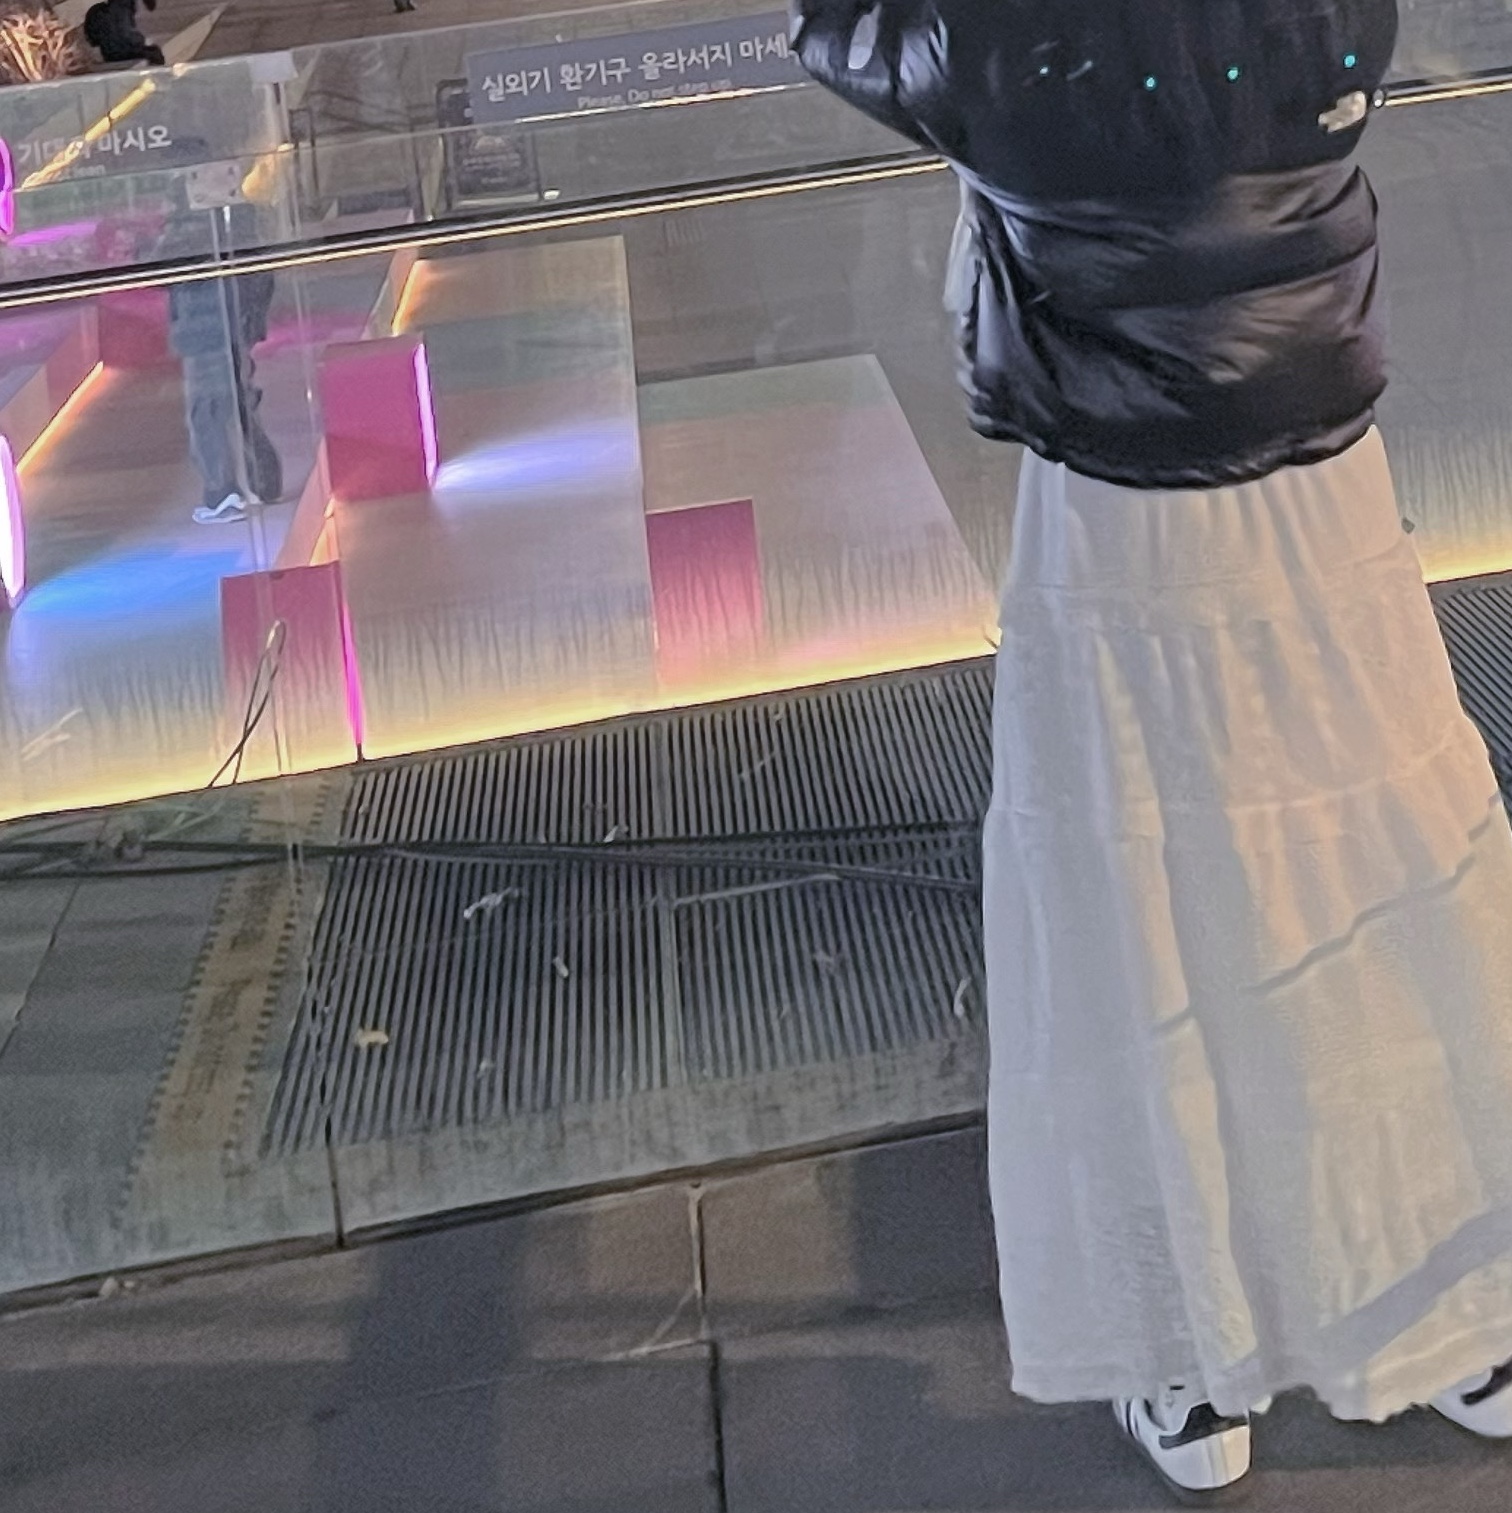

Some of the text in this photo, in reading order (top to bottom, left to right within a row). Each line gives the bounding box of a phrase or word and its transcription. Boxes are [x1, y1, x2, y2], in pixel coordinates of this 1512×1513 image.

[482, 32, 800, 102] 실외기 환기구 올라서지 마세
[98, 124, 173, 156] 마시오
